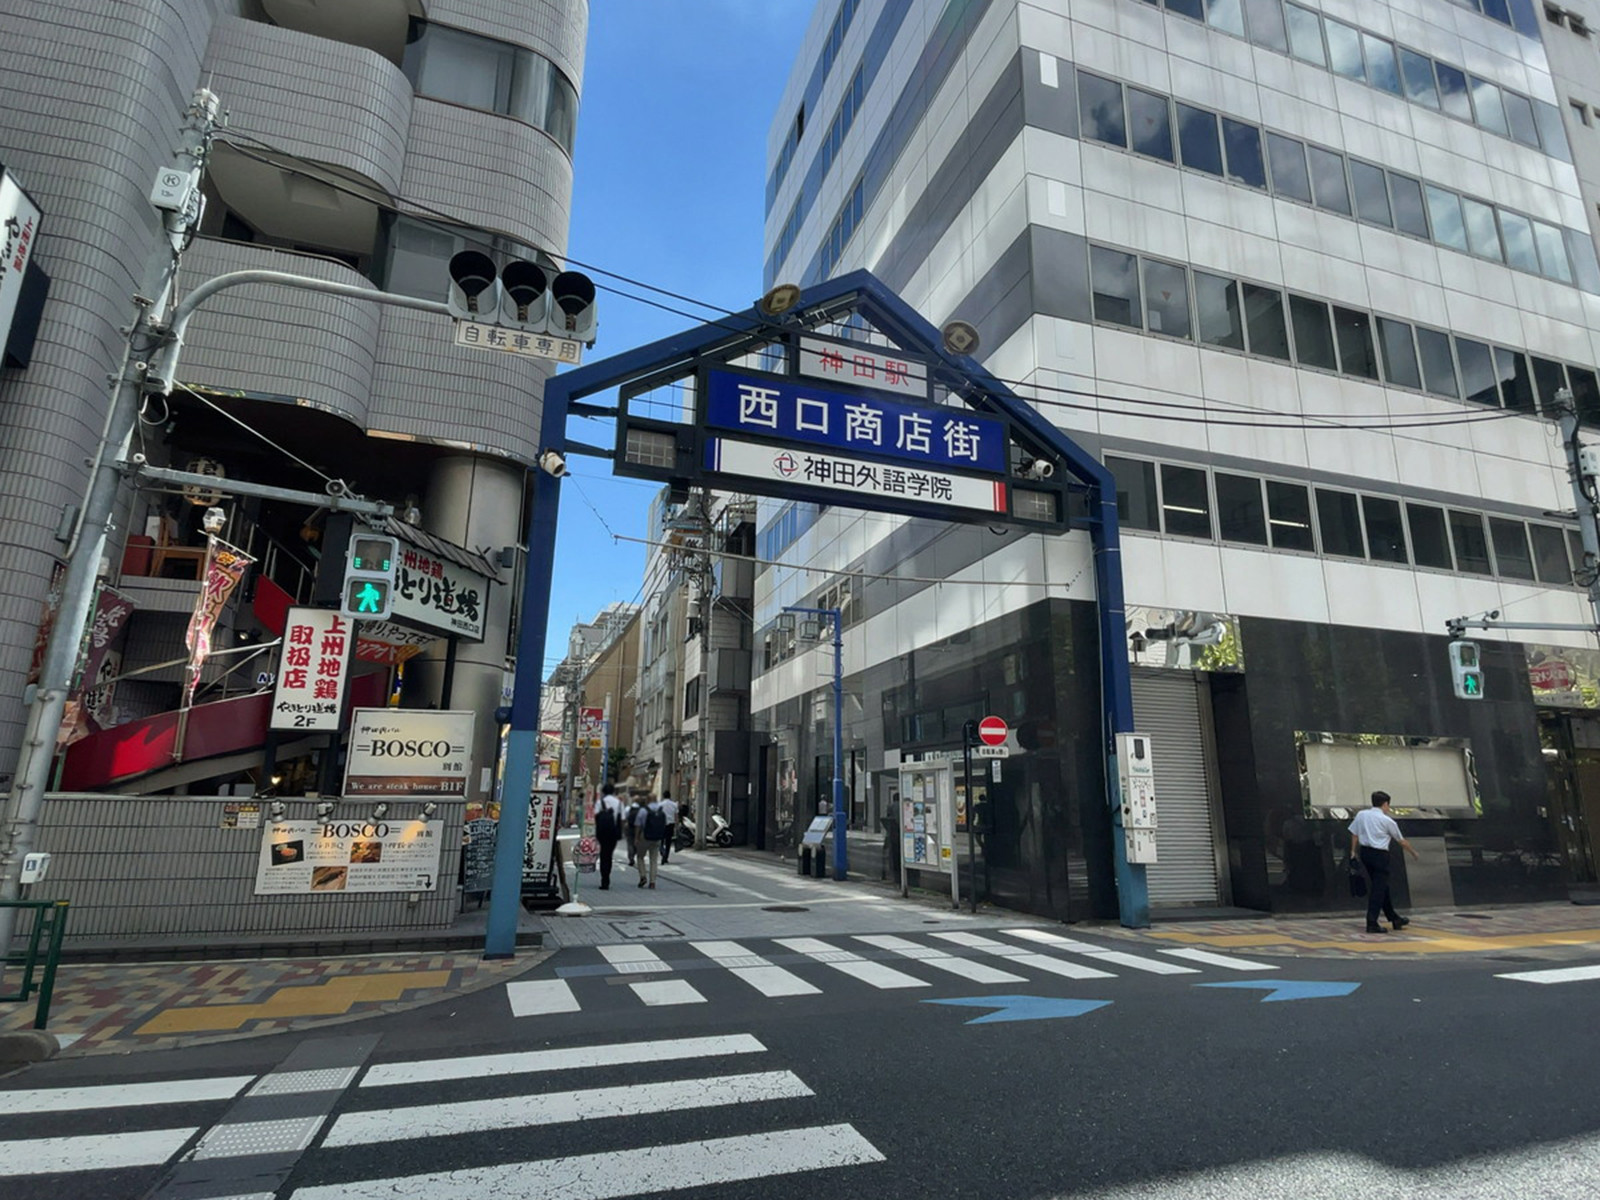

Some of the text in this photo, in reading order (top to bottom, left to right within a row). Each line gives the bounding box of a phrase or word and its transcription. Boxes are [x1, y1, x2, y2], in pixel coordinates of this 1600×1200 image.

[465, 325, 577, 359] 自転車専用
[819, 348, 910, 387] 神田駅
[738, 384, 981, 462] 西口商店街
[803, 456, 953, 501] 神田外語学院
[399, 549, 444, 580] 州地鶏
[283, 625, 314, 689] 取扱店
[313, 615, 347, 700] 上州地鶏
[293, 715, 317, 728] 2F
[371, 739, 451, 758] BOSCO
[351, 782, 365, 790] We
[386, 782, 409, 790] steak
[412, 782, 438, 791] house
[323, 822, 390, 838] BOSCO
